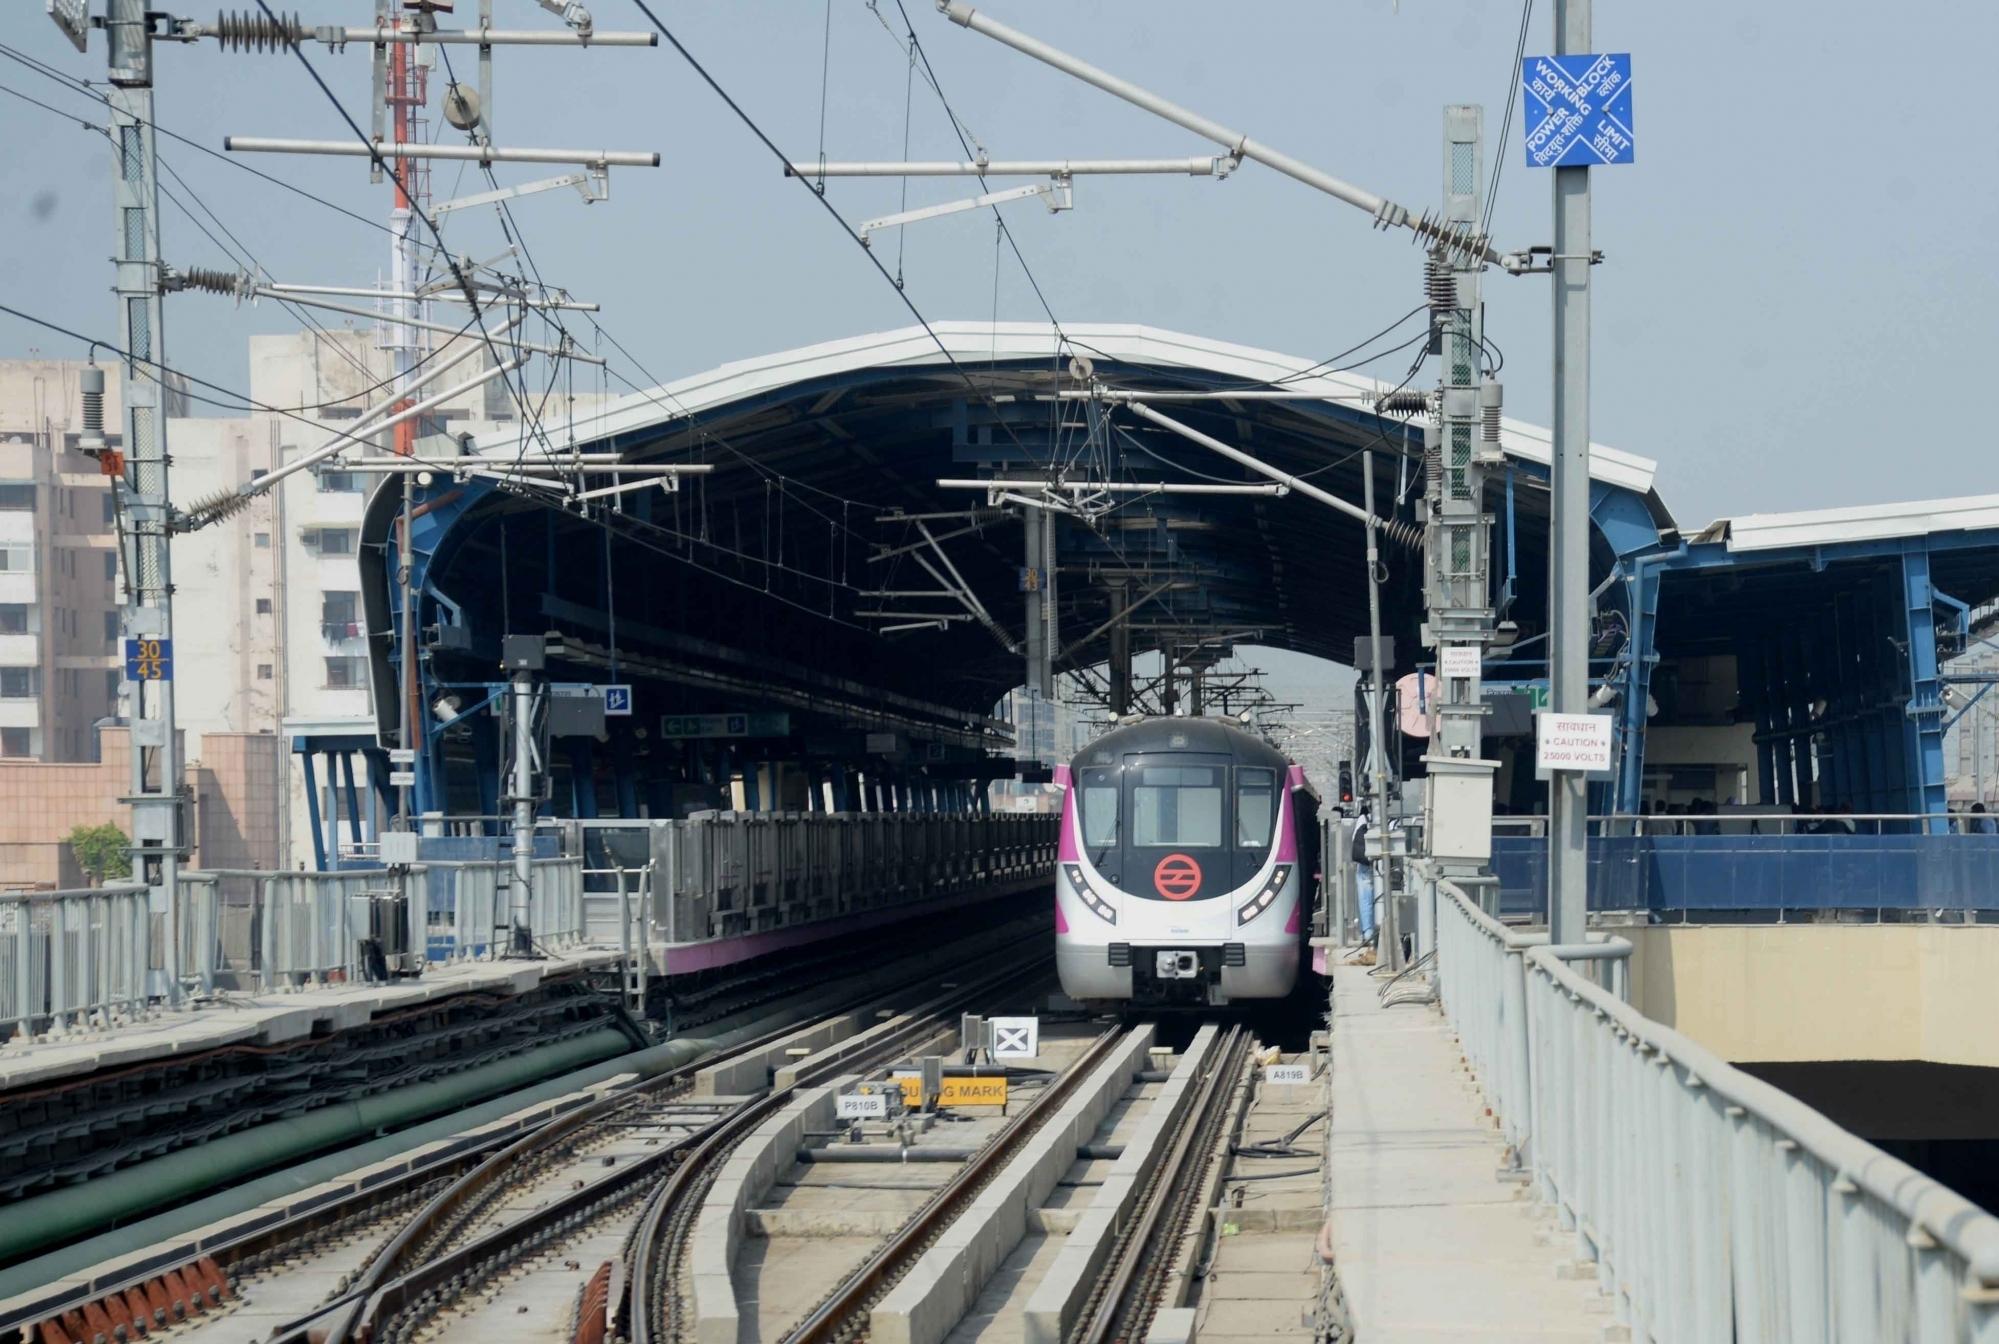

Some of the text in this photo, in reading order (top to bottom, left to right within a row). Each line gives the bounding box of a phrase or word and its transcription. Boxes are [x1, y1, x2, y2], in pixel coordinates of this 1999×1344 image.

[1527, 56, 1615, 152] POWER BLOCK
[1536, 60, 1631, 150] WORKING LIMIT
[137, 640, 160, 659] 30
[137, 661, 161, 679] 45
[1553, 738, 1598, 747] CAUTION
[1544, 752, 1605, 761] 25000 VOLTS
[959, 1085, 1003, 1097] MARK
